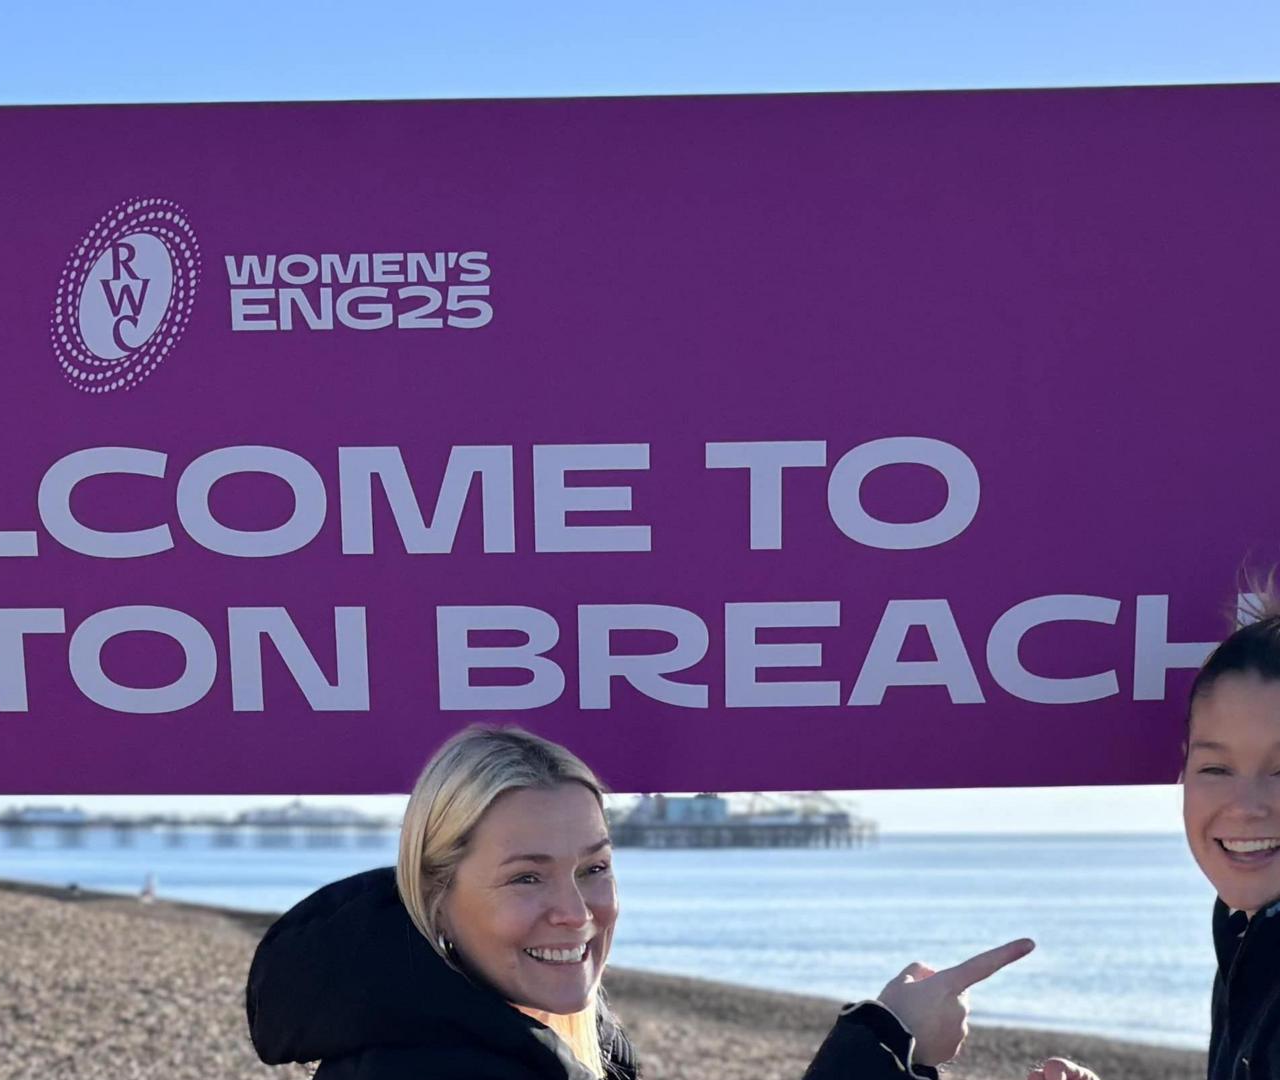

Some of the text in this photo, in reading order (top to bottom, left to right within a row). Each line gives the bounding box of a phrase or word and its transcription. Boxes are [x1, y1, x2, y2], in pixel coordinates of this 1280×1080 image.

[224, 251, 491, 285] WOMEN'S
[230, 286, 494, 331] ENG25
[705, 437, 981, 552] TO
[436, 592, 1270, 711] BREACH
